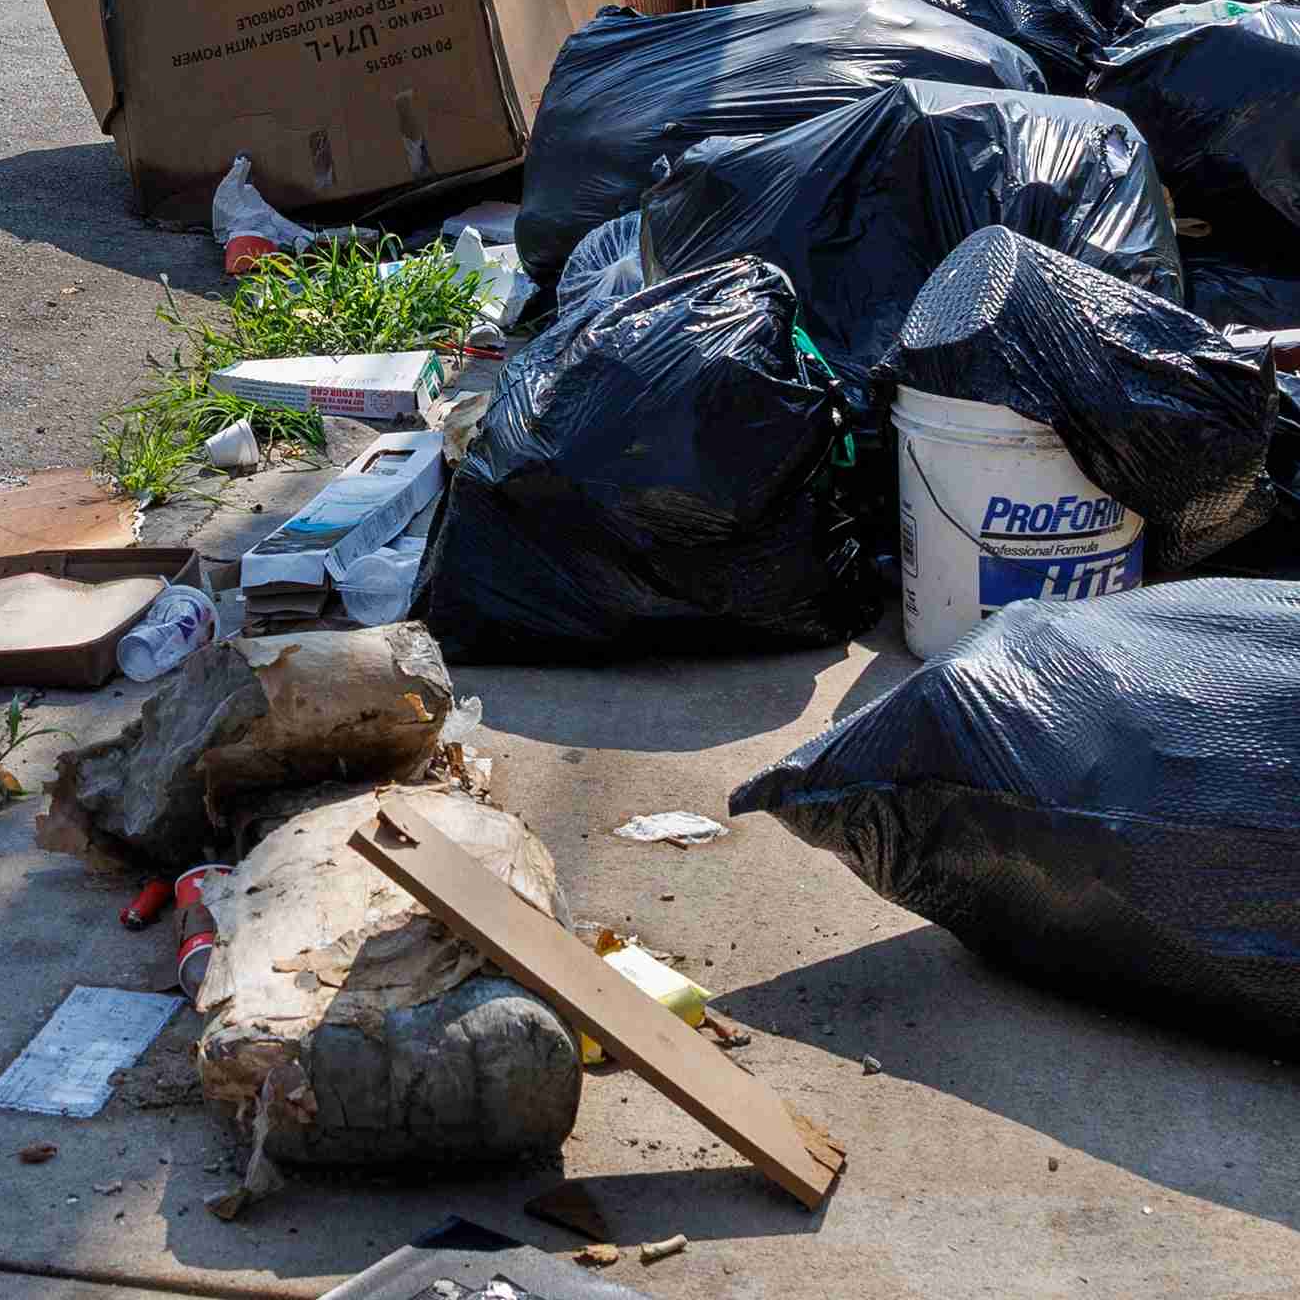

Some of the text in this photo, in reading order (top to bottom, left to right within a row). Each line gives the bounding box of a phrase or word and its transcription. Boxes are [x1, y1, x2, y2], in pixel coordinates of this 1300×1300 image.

[236, 4, 294, 30] CONSOLE
[326, 3, 374, 26] POWER
[388, 15, 408, 29] NO
[412, 3, 444, 23] ITEM
[260, 14, 324, 46] LOVESEAT
[225, 37, 256, 55] WITH
[304, 24, 378, 62] U71-L
[411, 43, 433, 59] NO
[172, 47, 222, 67] POWER
[330, 388, 354, 399] YOUR
[981, 542, 1100, 557] Professional Formula
[1040, 555, 1127, 600] LITE
